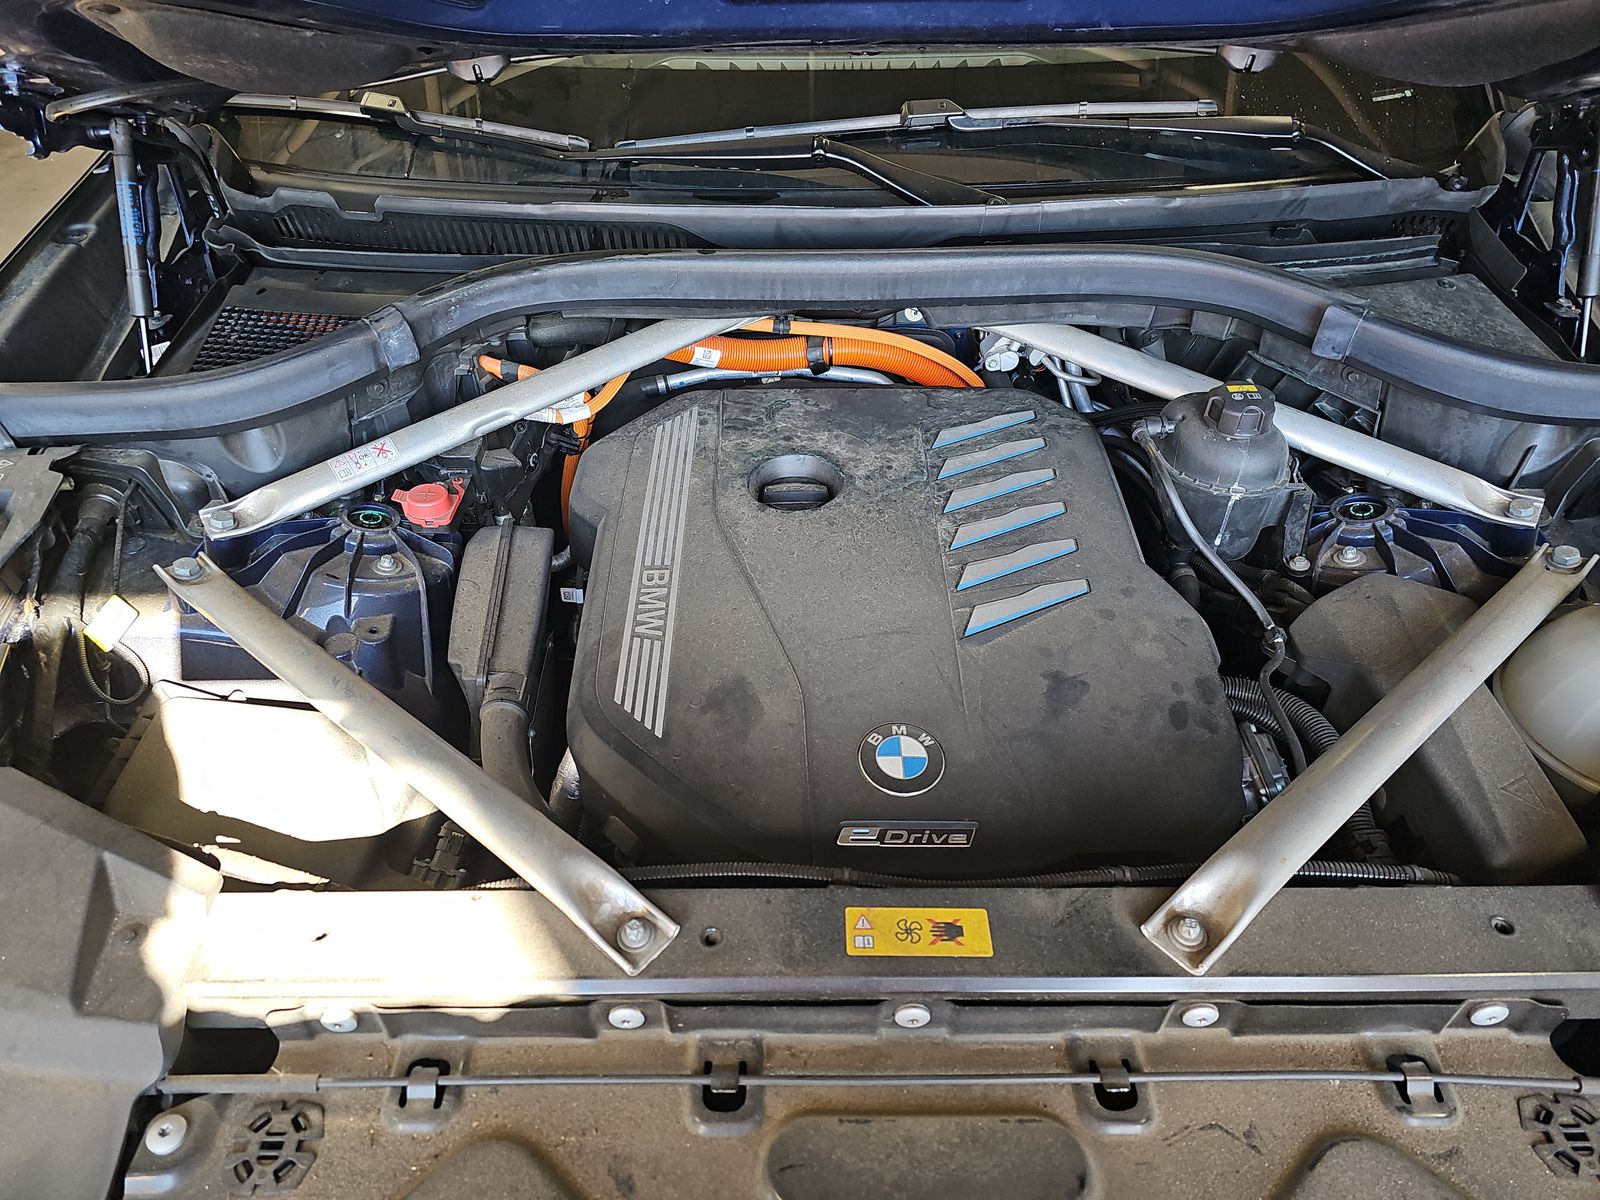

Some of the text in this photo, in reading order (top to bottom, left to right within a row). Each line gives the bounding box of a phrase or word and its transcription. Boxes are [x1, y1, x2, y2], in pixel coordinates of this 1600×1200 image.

[358, 452, 370, 461] OK
[634, 569, 670, 636] BMW
[866, 725, 936, 748] BMW
